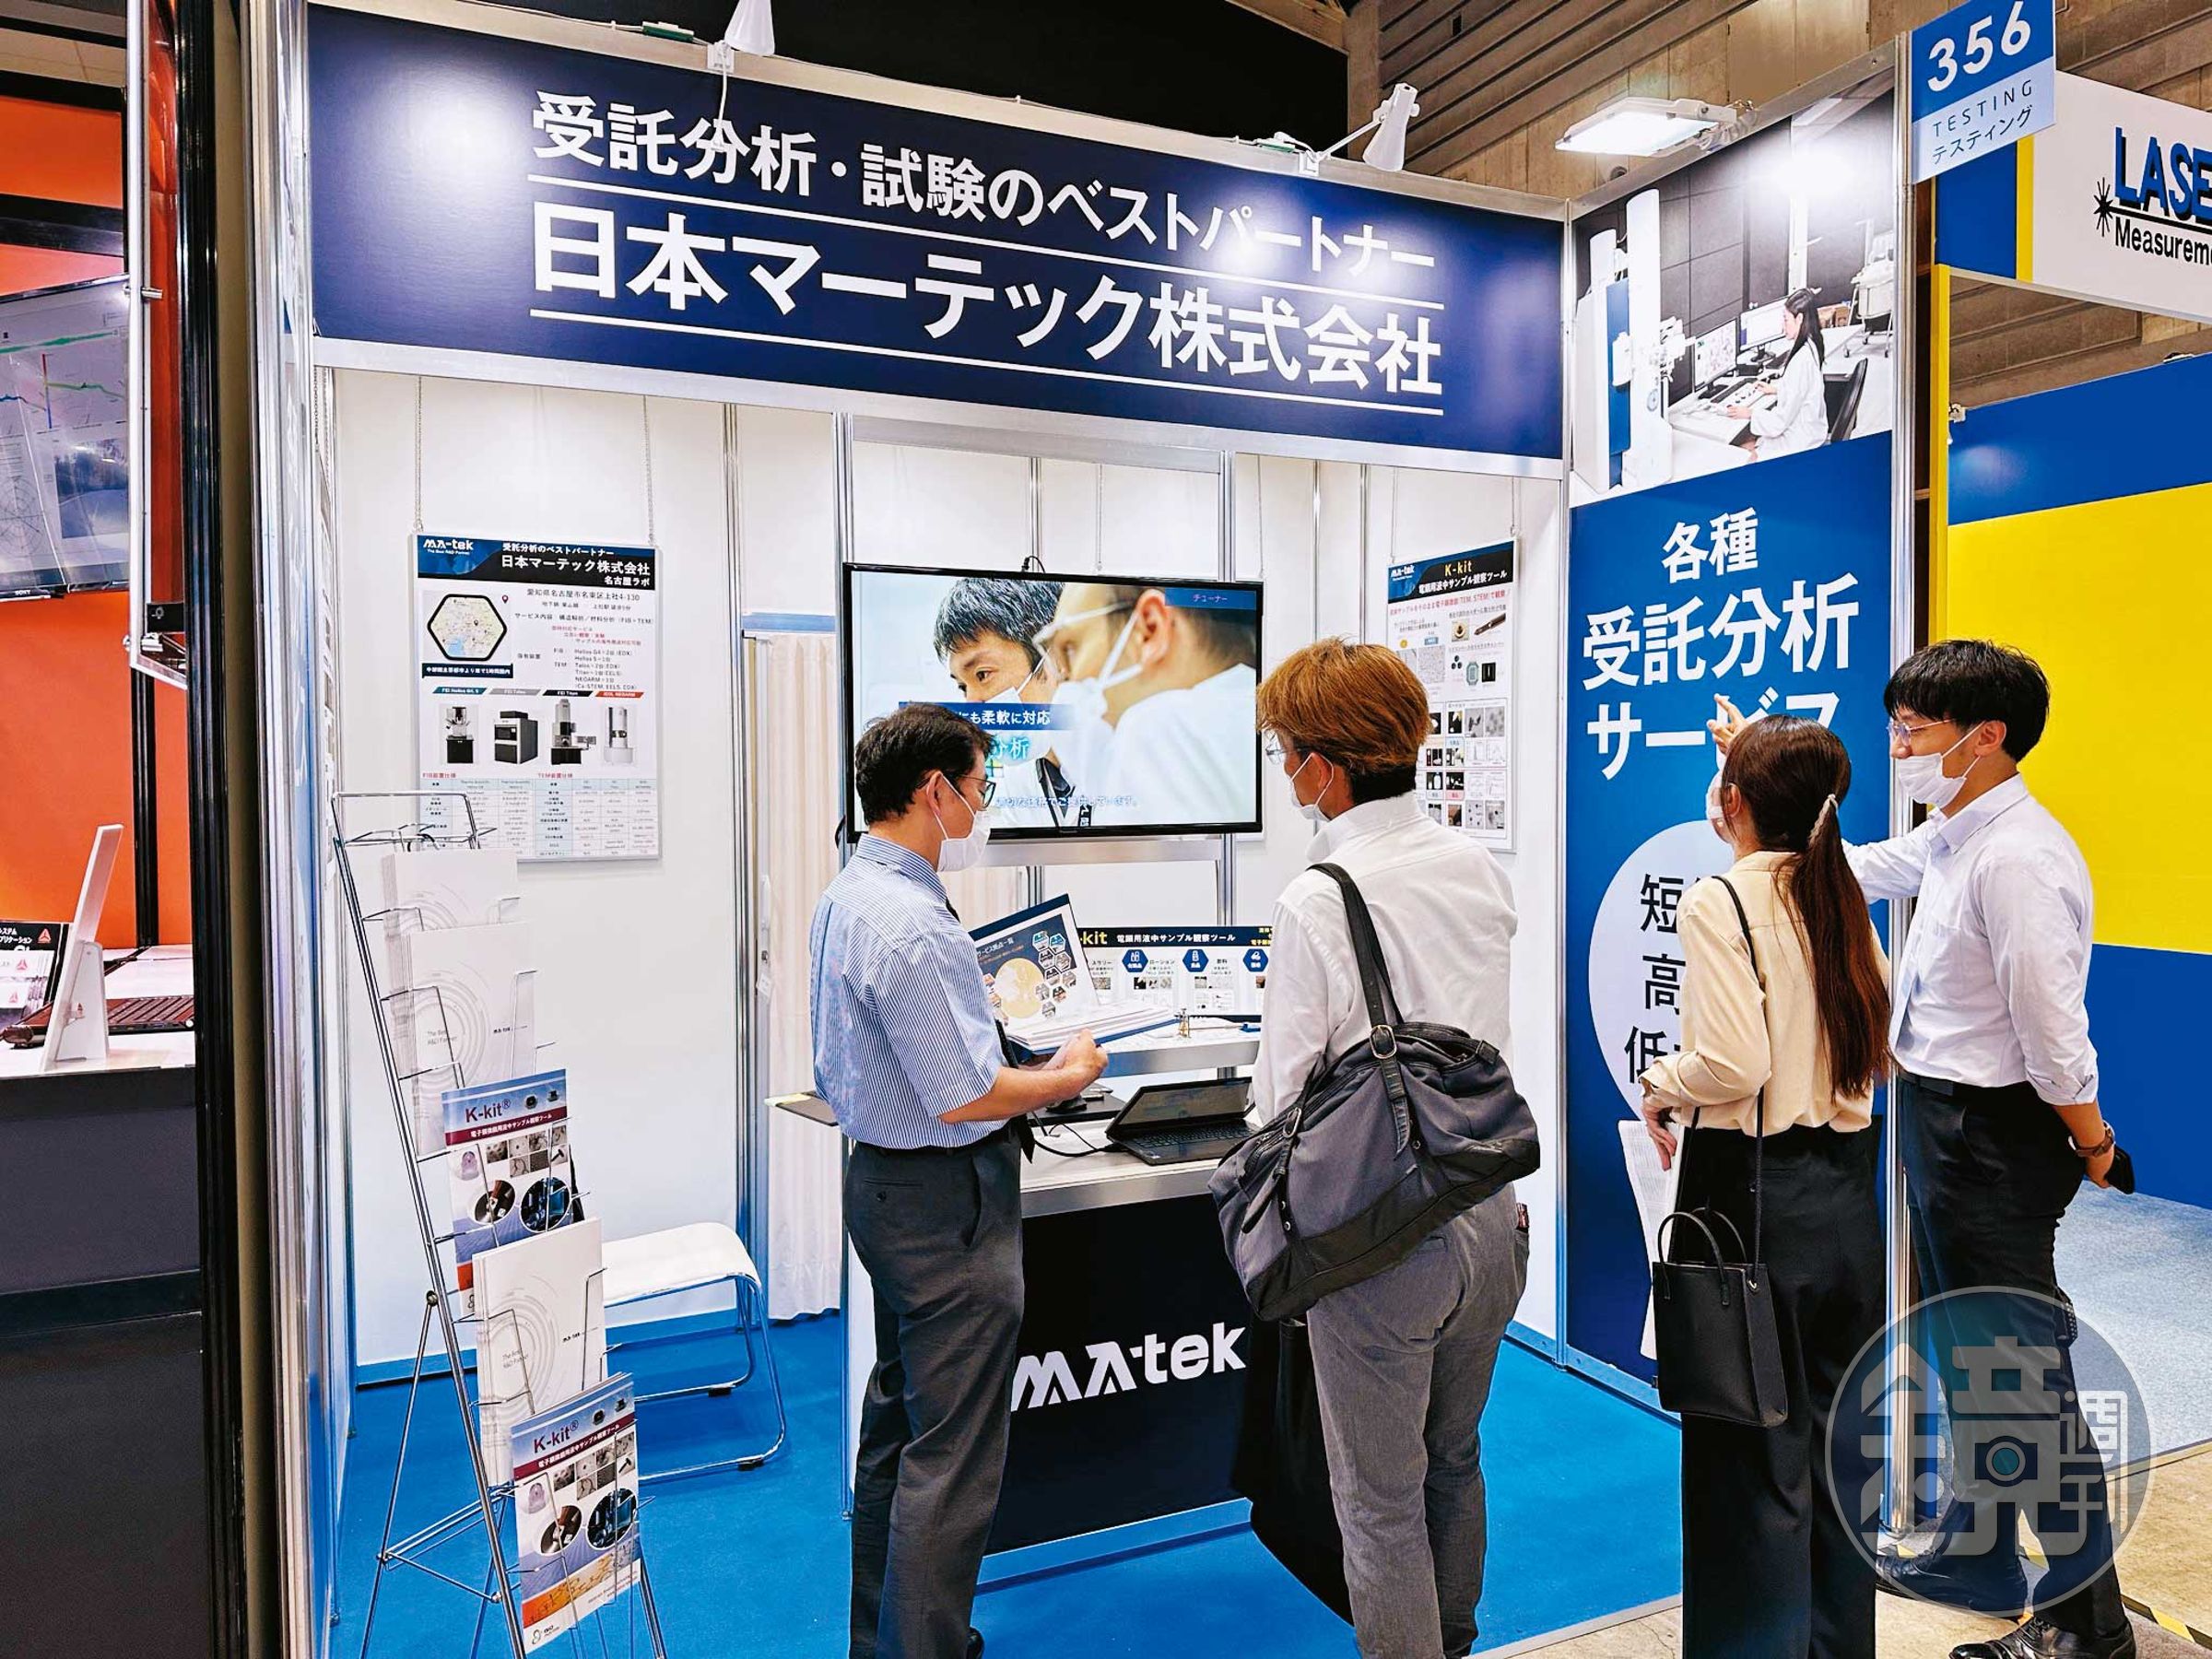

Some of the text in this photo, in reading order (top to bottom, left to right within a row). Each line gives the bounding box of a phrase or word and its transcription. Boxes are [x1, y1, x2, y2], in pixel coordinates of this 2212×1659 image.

[1926, 1, 2031, 92] 356
[1932, 79, 2032, 137] TESTING
[1932, 104, 2033, 165] テスティング
[533, 90, 1435, 276] 受託分析・試験のベストパートナー
[2114, 216, 2212, 266] Measurem
[533, 201, 1443, 395] 日本マーテック株式会社
[501, 554, 652, 576] 日本マーテック株式会社
[1444, 560, 1472, 577] K-kit
[1662, 507, 1759, 583] 各種
[1583, 572, 1860, 690] 受託分析
